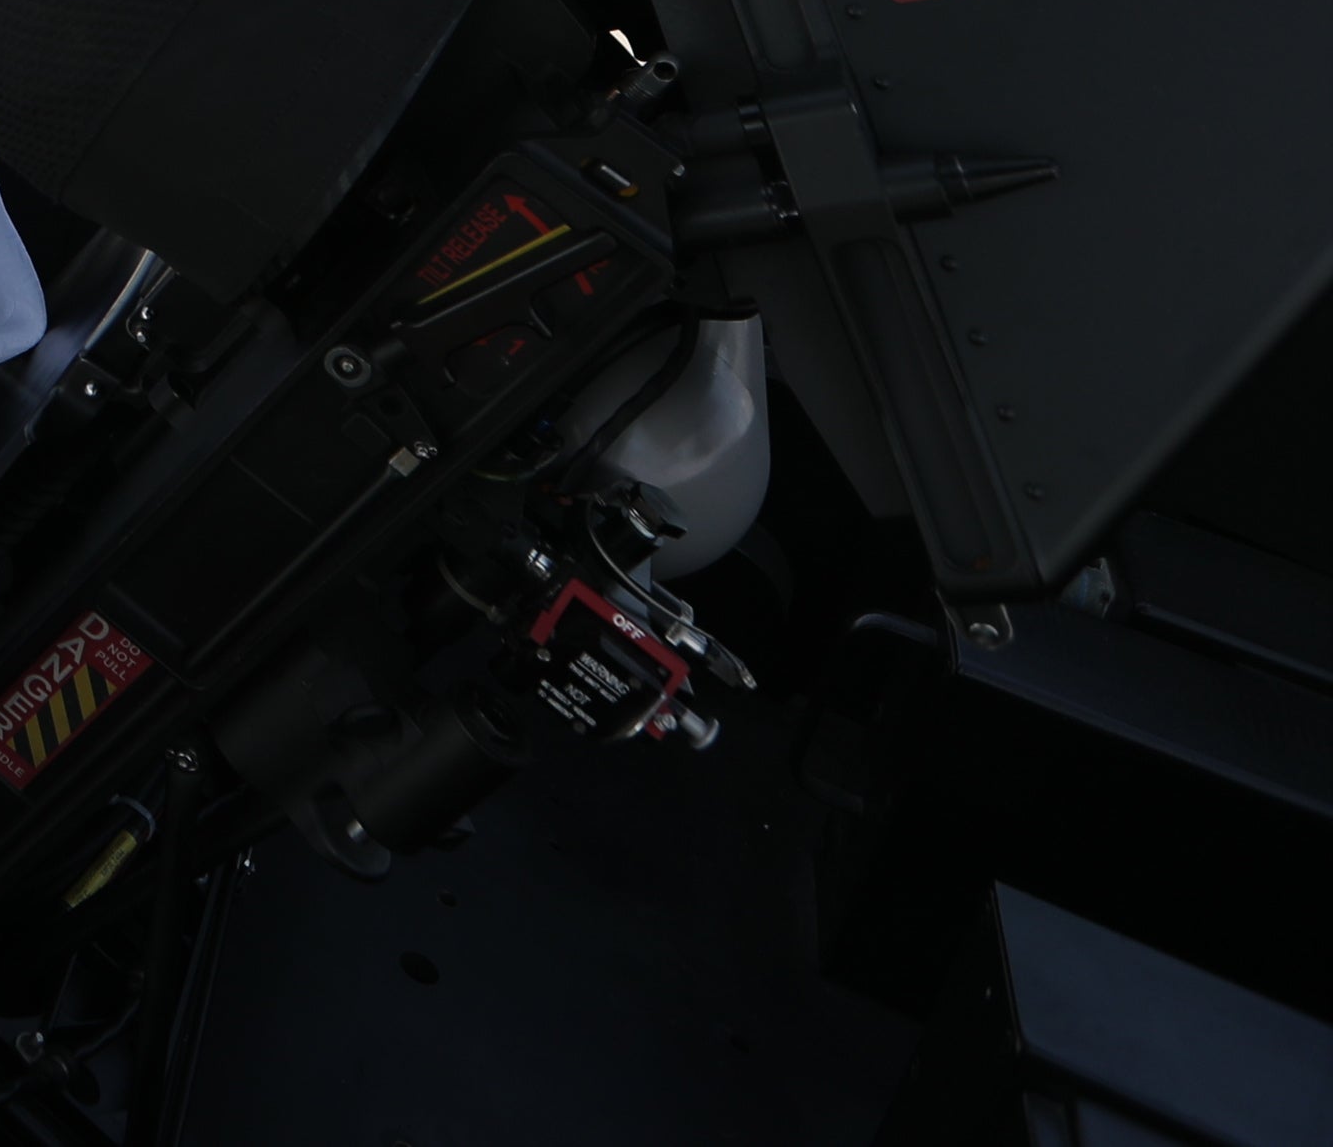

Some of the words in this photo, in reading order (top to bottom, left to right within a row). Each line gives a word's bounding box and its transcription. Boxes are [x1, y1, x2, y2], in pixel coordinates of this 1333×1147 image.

[417, 255, 454, 287] TILT
[441, 202, 508, 266] RELEASE
[613, 613, 646, 639] OFF
[107, 643, 137, 668] NOT
[119, 637, 141, 657] DO
[95, 650, 126, 681] PULL
[579, 651, 630, 694] WARNING
[564, 683, 592, 705] NOT
